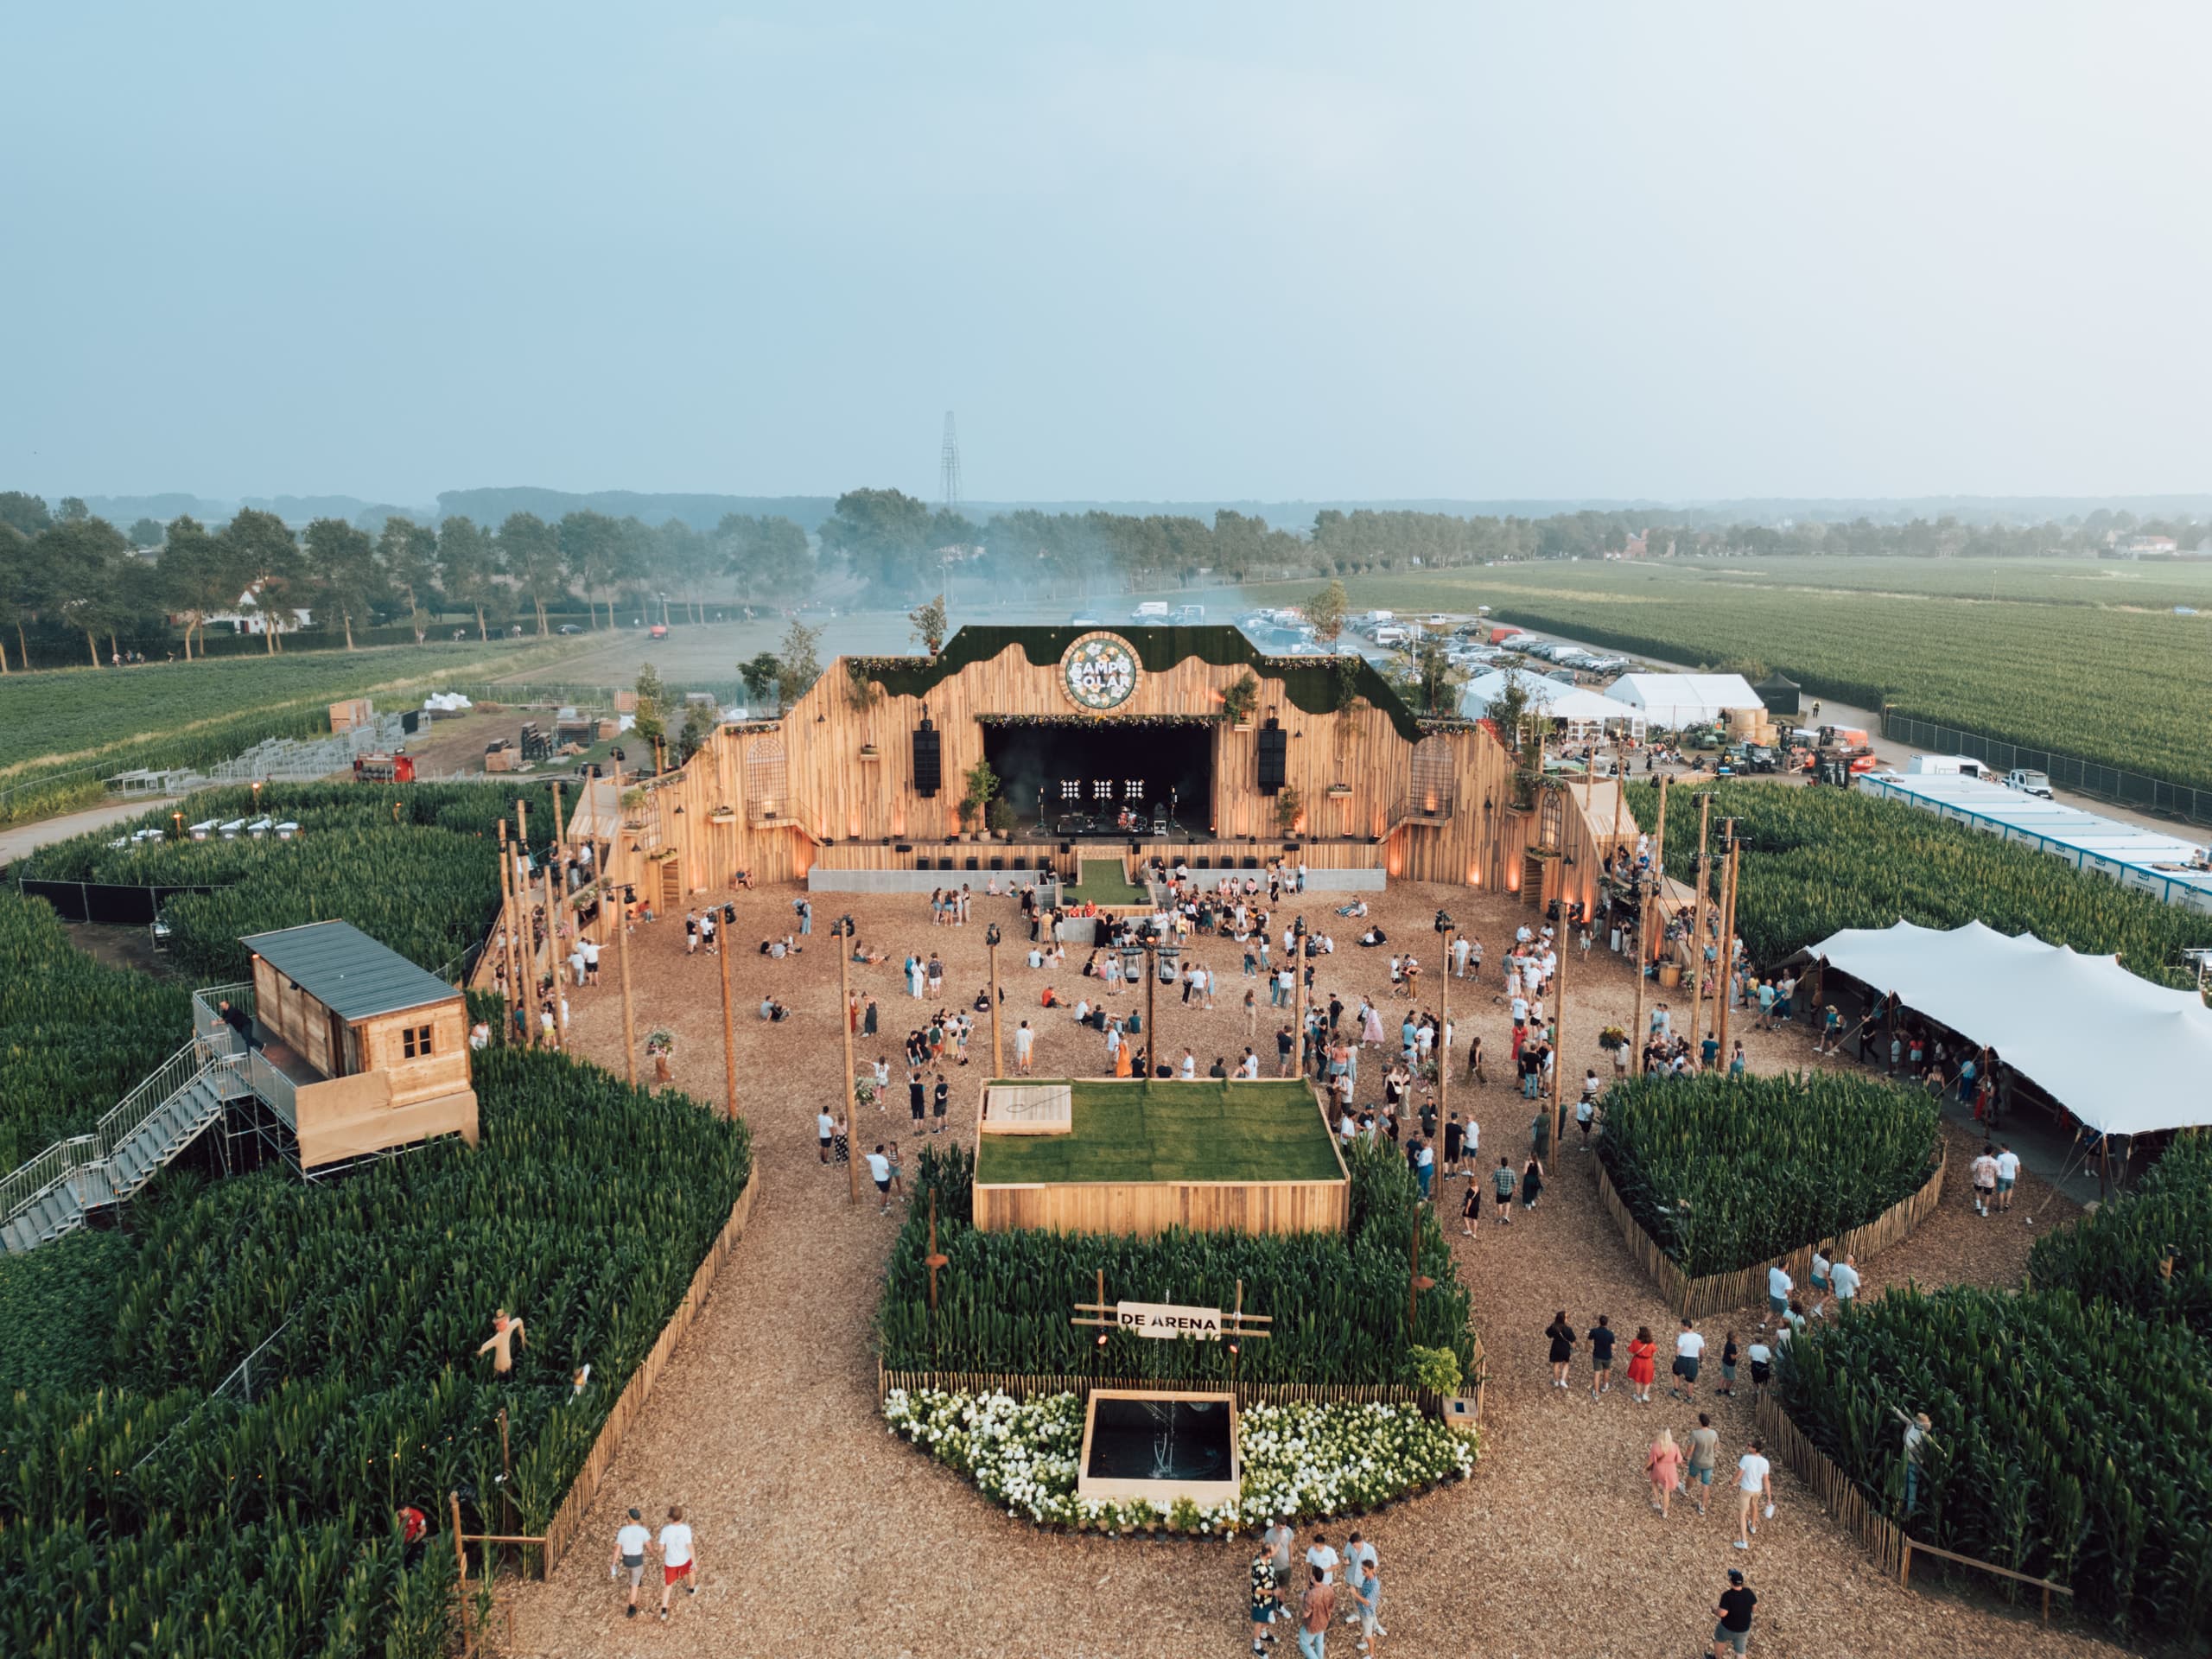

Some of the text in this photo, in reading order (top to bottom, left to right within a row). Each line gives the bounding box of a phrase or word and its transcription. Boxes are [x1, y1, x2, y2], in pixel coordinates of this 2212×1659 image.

[1071, 662, 1130, 674] CAMPO
[1072, 676, 1130, 688] SOLAR
[1121, 1313, 1217, 1331] DE ARENA
